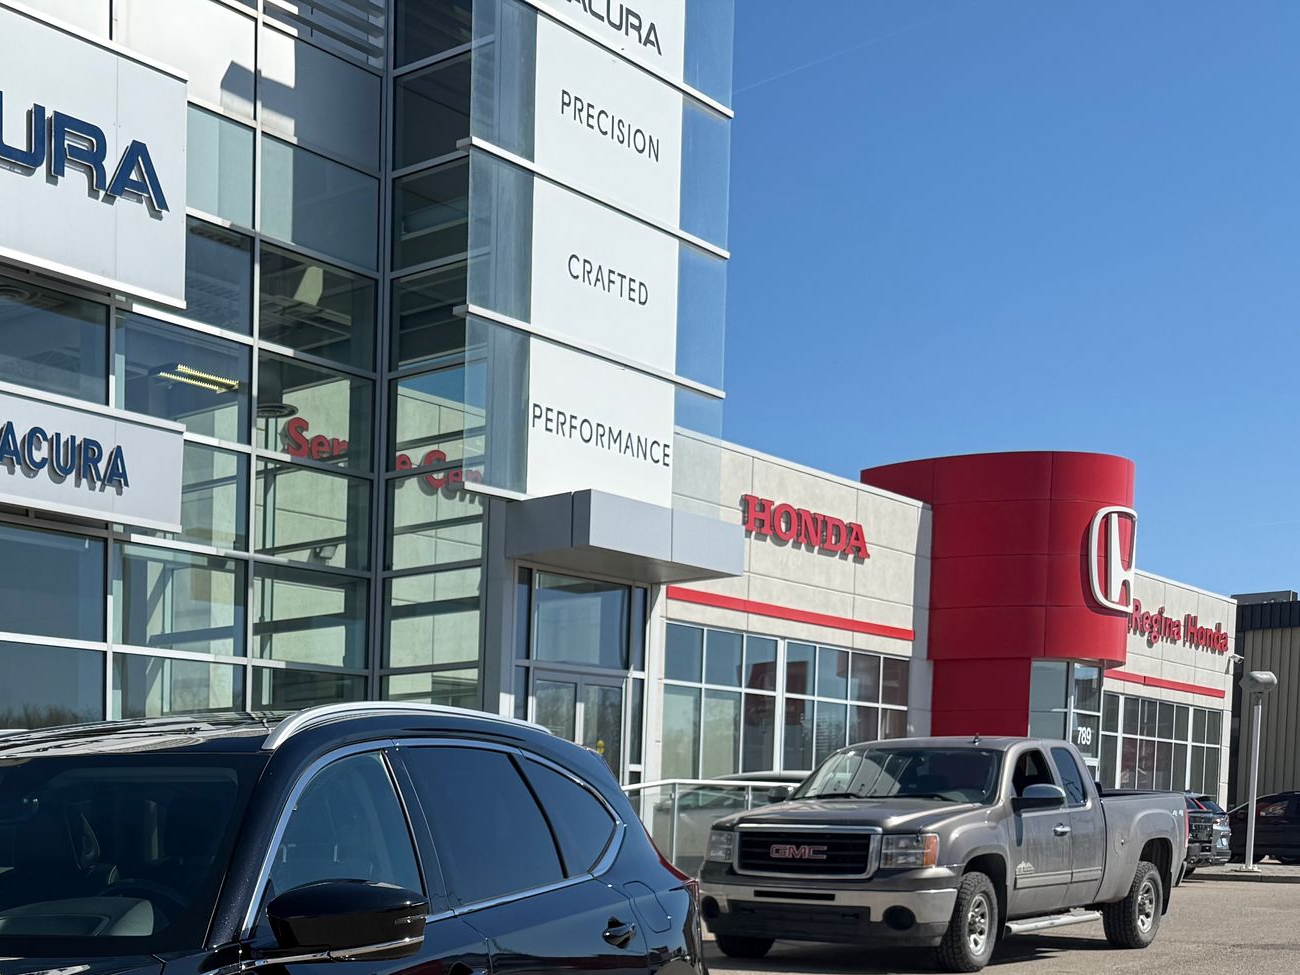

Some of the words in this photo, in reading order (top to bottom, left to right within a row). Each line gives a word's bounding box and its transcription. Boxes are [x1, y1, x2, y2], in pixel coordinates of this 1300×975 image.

[561, 89, 660, 162] PRECISION
[567, 253, 649, 306] CRAFTED
[532, 402, 671, 467] PERFORMANCE
[743, 494, 870, 559] HONDA
[1132, 598, 1181, 644] Regina
[1184, 612, 1229, 653] Honda
[1077, 726, 1092, 745] 789
[769, 843, 828, 860] GMC
